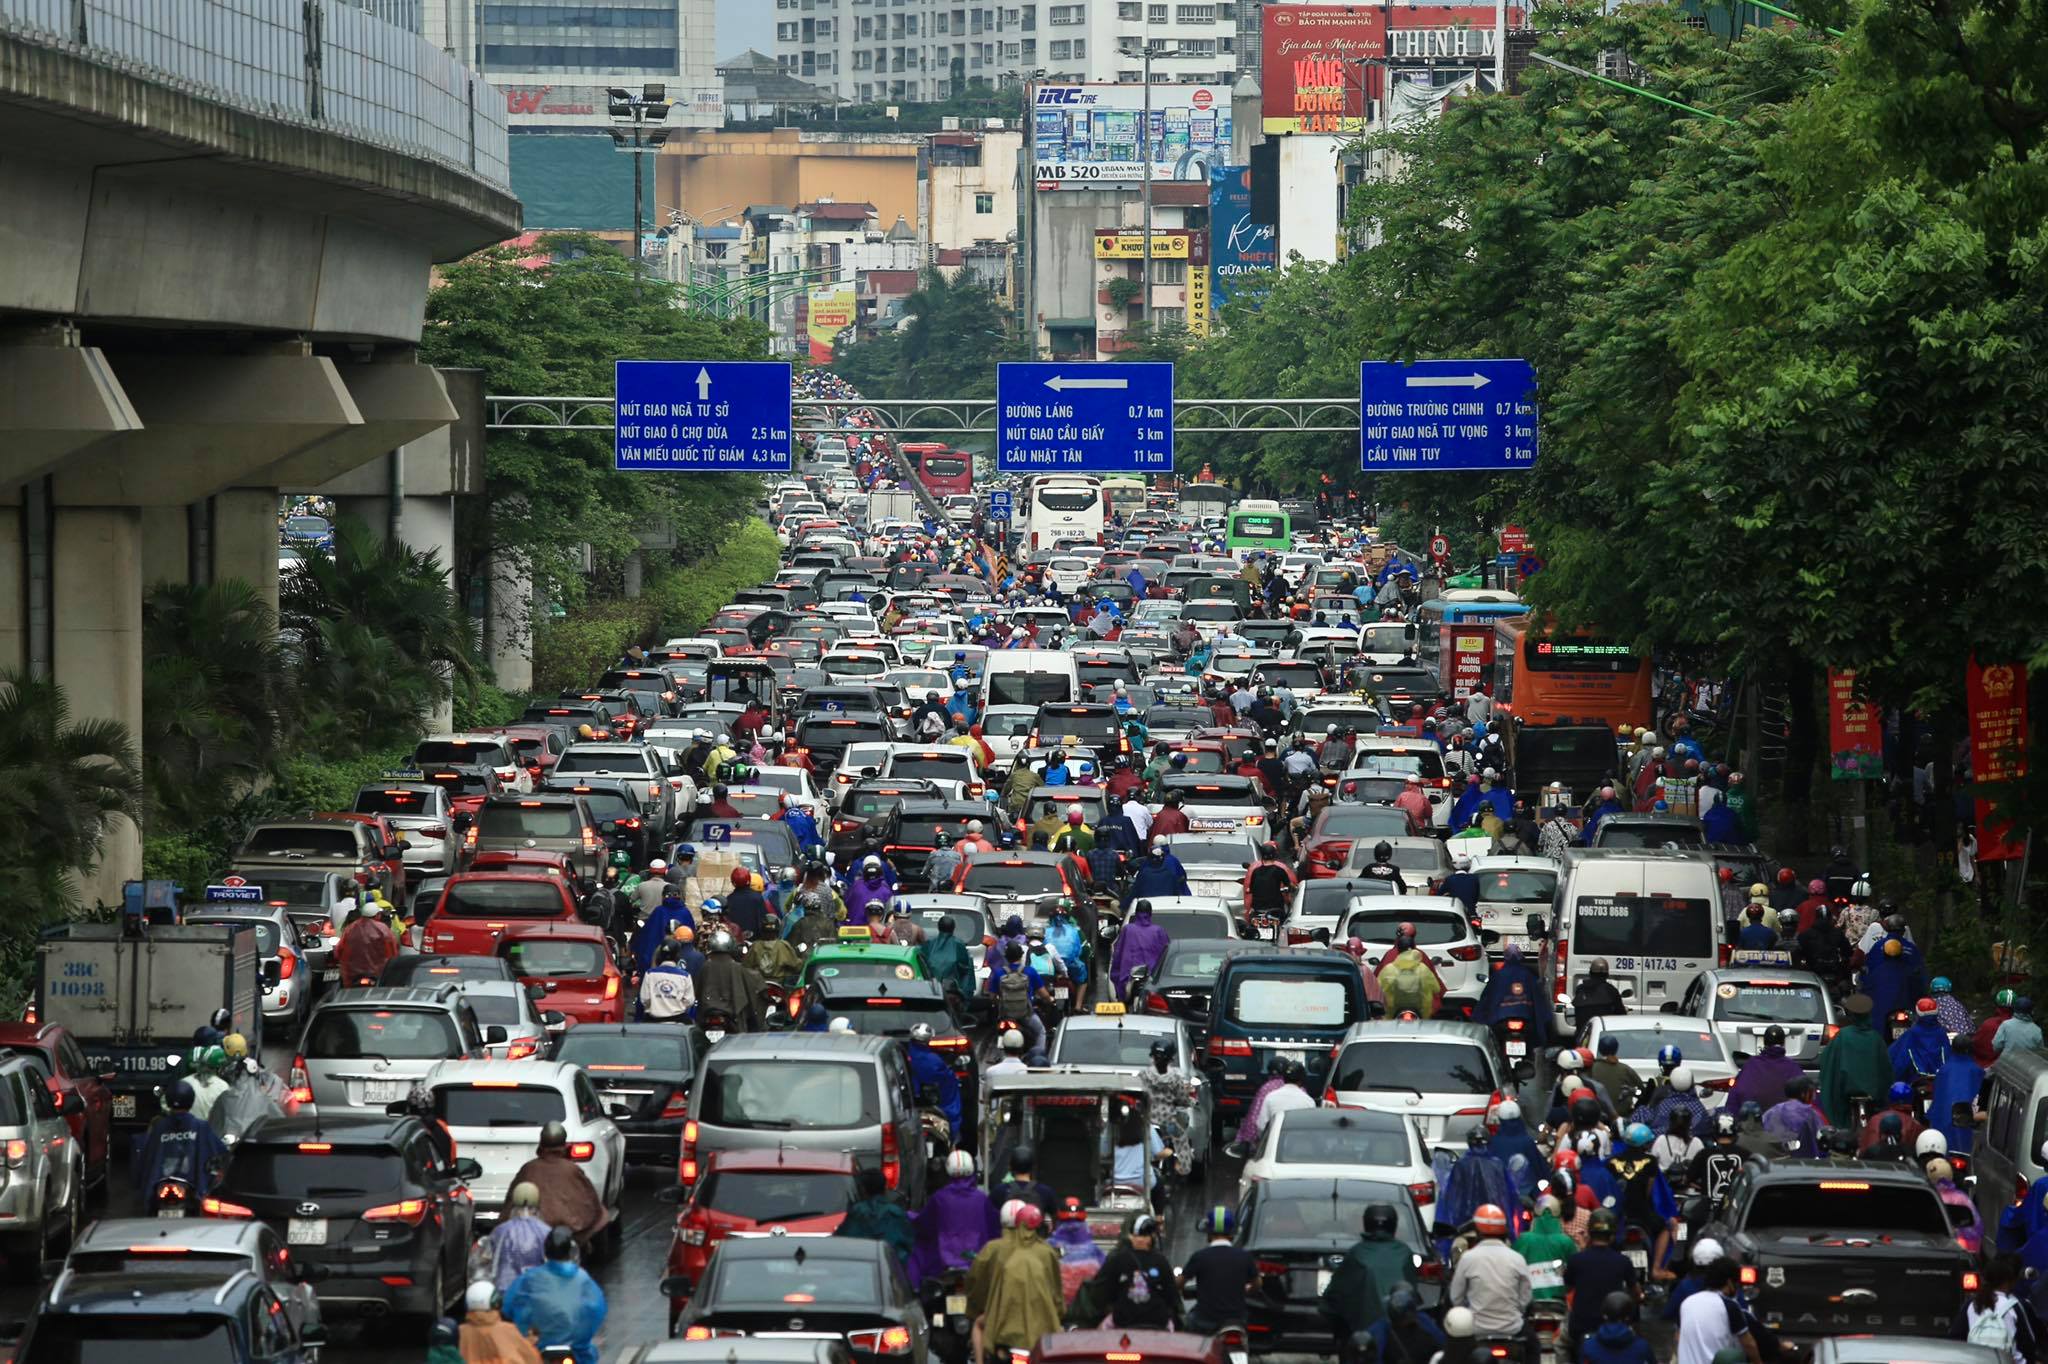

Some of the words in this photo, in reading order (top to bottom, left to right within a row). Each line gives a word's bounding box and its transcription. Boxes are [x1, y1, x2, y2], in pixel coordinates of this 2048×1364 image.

[541, 104, 593, 115] CINEMAS
[1036, 166, 1066, 179] MB
[1070, 166, 1100, 179] 520
[1217, 264, 1242, 275] GIỮA
[621, 401, 640, 416] NÚT
[644, 403, 668, 416] GIAO
[671, 402, 693, 417] NGÃ
[697, 404, 712, 417] TƯ
[715, 401, 730, 417] SỞ
[1006, 402, 1041, 418] ĐƯỜNG
[1046, 401, 1073, 418] LÁNG
[1147, 406, 1164, 418] km
[1367, 400, 1403, 417] ĐƯỜNG
[1407, 400, 1449, 416] TRƯỜNG
[1452, 403, 1484, 416] CHINH
[621, 423, 640, 439] NÚT
[644, 426, 667, 439] GIAO
[671, 423, 678, 439] Ô
[682, 426, 704, 442] CHỢ
[707, 423, 728, 439] DỪA
[770, 428, 787, 440] km
[1006, 424, 1026, 440] NÚT
[1030, 428, 1054, 440] GIAO
[1058, 424, 1078, 441] CẦU
[1082, 424, 1105, 440] GIẤY
[1137, 428, 1144, 441] 5
[1147, 428, 1164, 440] km
[1368, 422, 1388, 439] NÚT
[1391, 426, 1414, 439] GIAO
[1418, 423, 1439, 438] NGÃ
[1443, 425, 1457, 438] TƯ
[1460, 425, 1488, 440] VỌNG
[1504, 425, 1511, 438] 3
[1515, 425, 1532, 437] km
[621, 445, 641, 460] VĂN
[643, 444, 669, 461] MIẾU
[672, 444, 699, 461] QUỐC
[703, 445, 716, 461] TỬ
[719, 445, 745, 461] GIÁM
[770, 450, 787, 462] km
[1006, 446, 1026, 462] CẦU
[1030, 447, 1057, 464] NHẬT
[1062, 447, 1083, 462] TÂN
[1134, 450, 1144, 462] 11
[1147, 450, 1164, 462] km
[1368, 445, 1388, 462] CẦU
[1393, 446, 1417, 461] VĨNH
[1421, 448, 1441, 460] TUY
[1505, 447, 1512, 460] 8
[1515, 447, 1532, 460] km
[1616, 958, 1634, 970] 29B
[1645, 959, 1677, 971] 417.43
[51, 981, 105, 996] 11098
[123, 1056, 167, 1071] 110.98
[1767, 1312, 1950, 1327] RANGER
